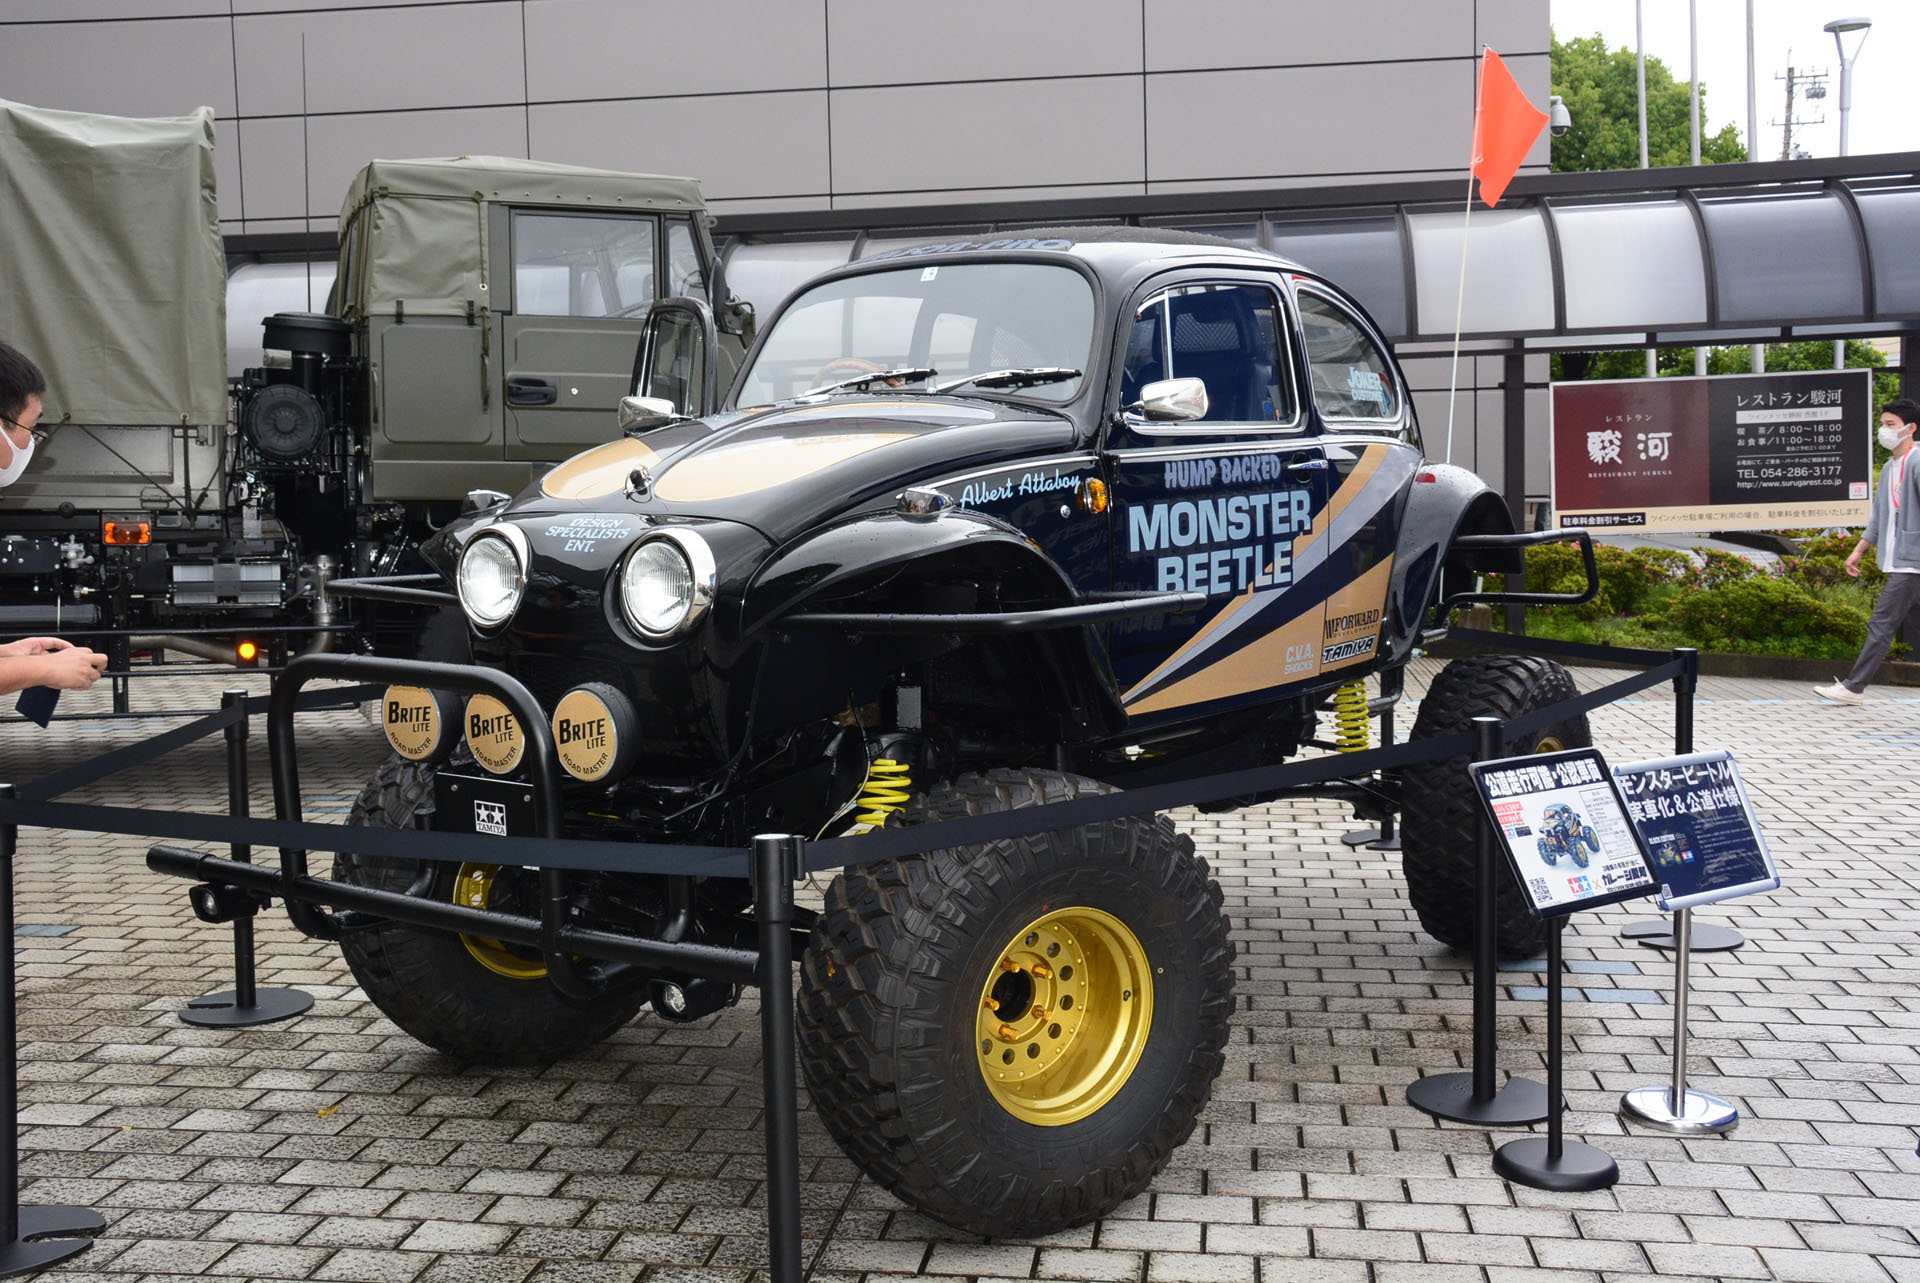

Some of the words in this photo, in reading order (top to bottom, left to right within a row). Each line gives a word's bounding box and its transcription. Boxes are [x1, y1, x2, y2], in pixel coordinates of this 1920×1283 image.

[1347, 366, 1383, 390] JOKER
[1737, 389, 1842, 407] レストラン駿河
[1606, 414, 1653, 423] レストラン
[1164, 459, 1217, 489] HUMP
[1219, 454, 1281, 485] BACKED
[1737, 469, 1759, 479] TEL
[1760, 466, 1842, 478] 054-286-3177
[960, 477, 1014, 509] Albert
[1019, 468, 1081, 495] Attaboy
[1737, 478, 1842, 489] http://www.surugarest.co.jp
[569, 518, 624, 529] DESIGN
[1129, 489, 1311, 552] MONSTER
[1562, 514, 1643, 526] 駐車料金割引サービス
[545, 526, 630, 539] SPECIALISTS
[564, 539, 595, 553] ENT.
[1158, 540, 1293, 595] BEETLE
[1323, 636, 1375, 663] TAMIYA
[388, 701, 431, 724] BRITE
[412, 723, 431, 733] LITE
[470, 713, 514, 739] BRITE
[558, 717, 606, 745] BRITE
[389, 732, 407, 754] ROAD
[407, 737, 432, 755] MASTER
[495, 731, 515, 744] LITE
[586, 734, 606, 750] LITE
[474, 746, 493, 766] ROAD
[493, 746, 517, 767] MASTER
[563, 752, 583, 774] ROAD
[582, 752, 609, 776] MASTER
[1484, 758, 1602, 797] 公道走行可能・公認車両
[1619, 761, 1731, 795] モンスタービートル
[476, 823, 506, 835] TAMIYA
